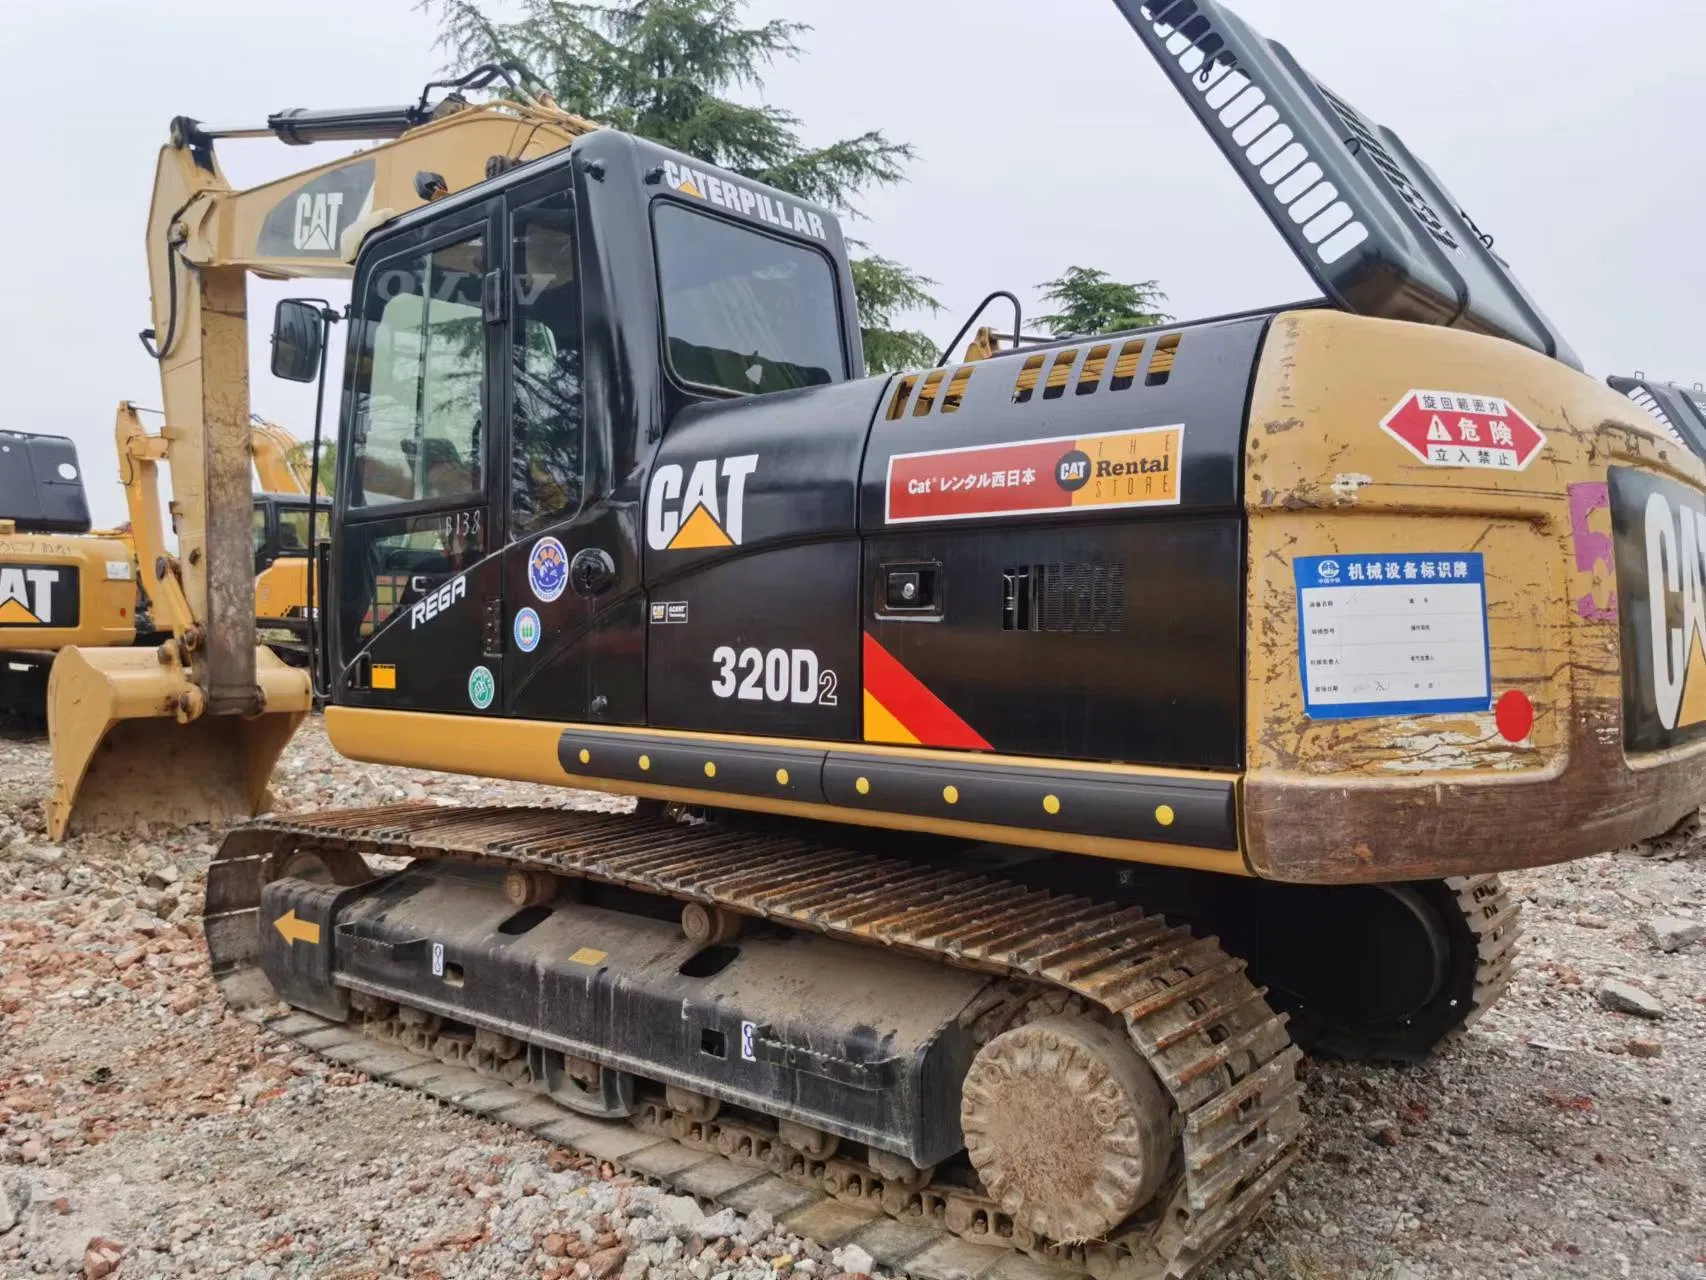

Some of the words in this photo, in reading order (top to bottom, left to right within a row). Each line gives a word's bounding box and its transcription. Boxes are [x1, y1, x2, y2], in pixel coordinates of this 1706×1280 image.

[663, 160, 827, 240] CATERPILLAR
[293, 192, 344, 251] CAT
[1097, 434, 1171, 457] THE
[1457, 417, 1514, 447] 危険
[1059, 460, 1086, 481] CAT
[1096, 454, 1169, 477] Rental
[1435, 448, 1511, 467] 立入禁止
[940, 467, 1036, 491] レンタル西日本
[1096, 477, 1171, 498] STORE
[646, 453, 759, 550] CAT
[1347, 560, 1469, 581] 机械设备标识牌
[0, 568, 59, 623] AT
[411, 575, 467, 630] REGA
[1644, 492, 1706, 729] CA
